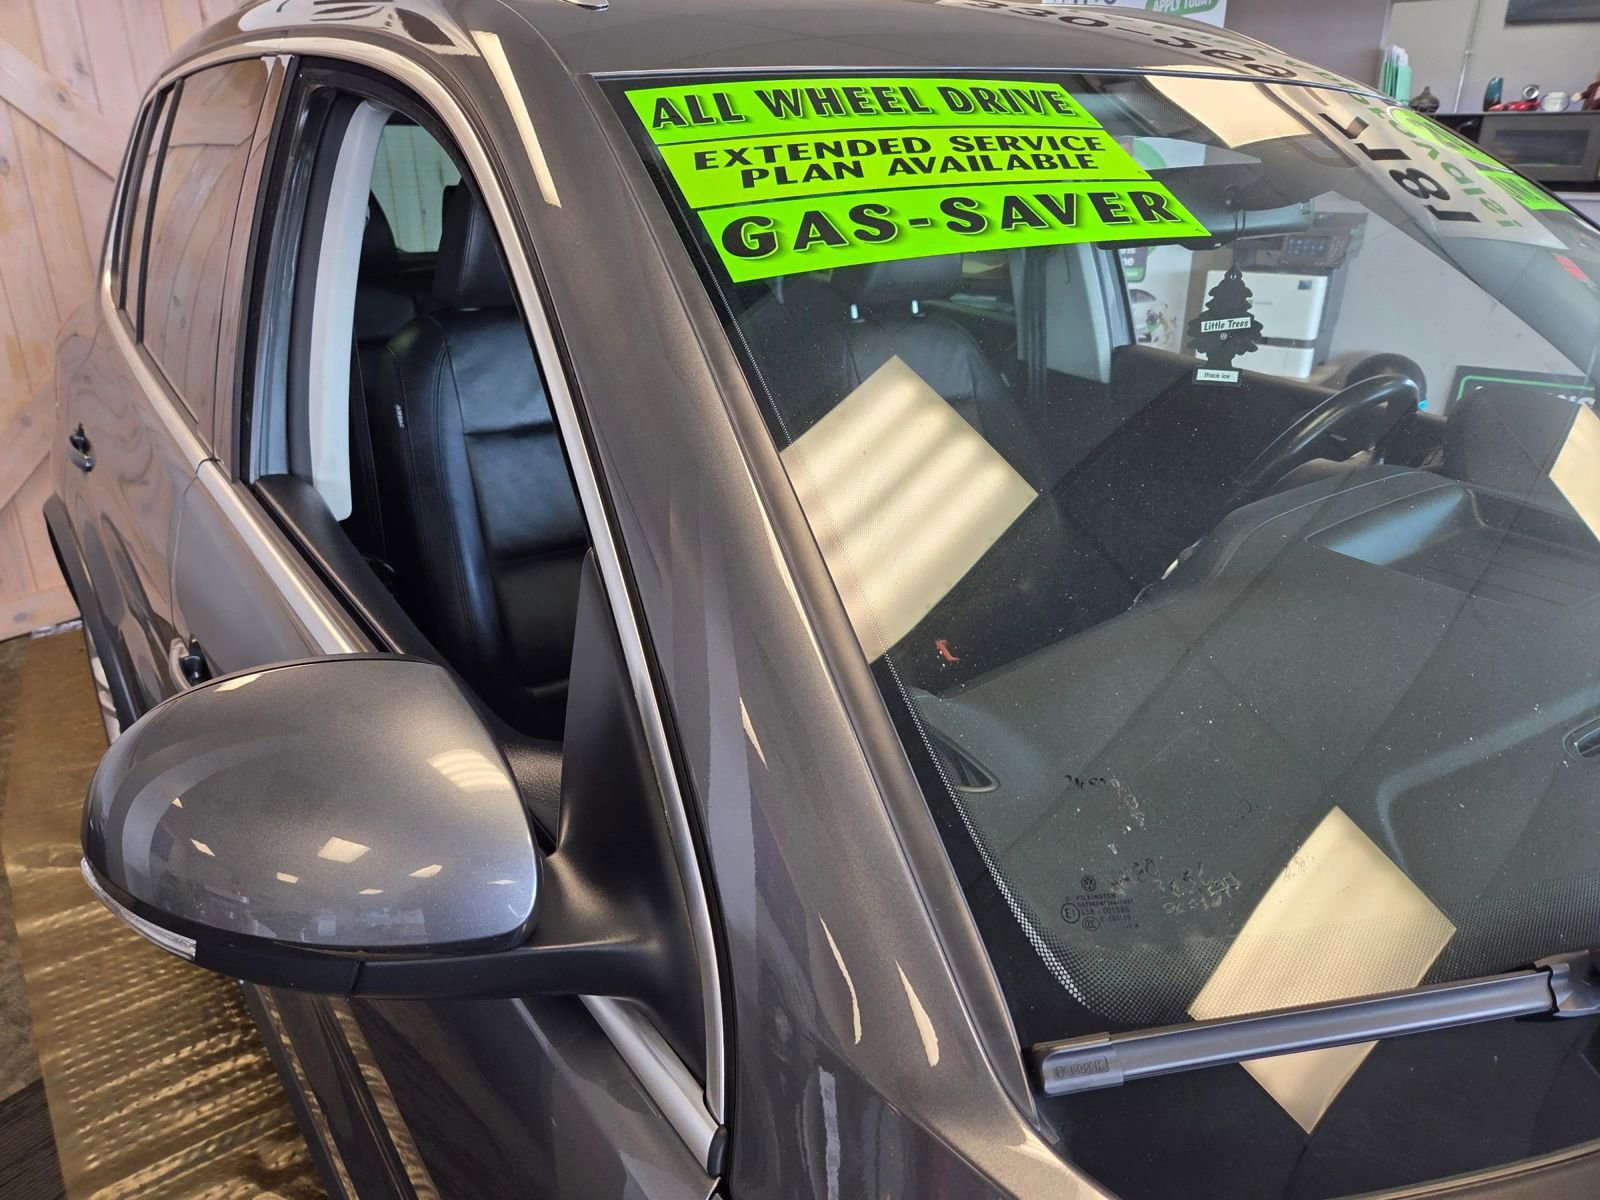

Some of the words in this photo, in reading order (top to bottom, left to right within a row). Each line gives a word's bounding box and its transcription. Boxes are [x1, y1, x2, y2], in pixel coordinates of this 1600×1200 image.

[1153, 0, 1182, 12] APPLY
[652, 92, 749, 130] ALL
[754, 86, 933, 119] WHEEL
[936, 86, 1078, 116] DRIVE
[694, 138, 931, 170] EXTENDED
[950, 135, 1106, 153] SERVICE
[742, 160, 864, 188] PLAN
[887, 153, 1099, 176] AVAILABLE
[721, 190, 1182, 260] GAS-SAVER
[1204, 320, 1225, 331] Little
[1227, 319, 1249, 331] Trees
[1204, 371, 1220, 379] Black
